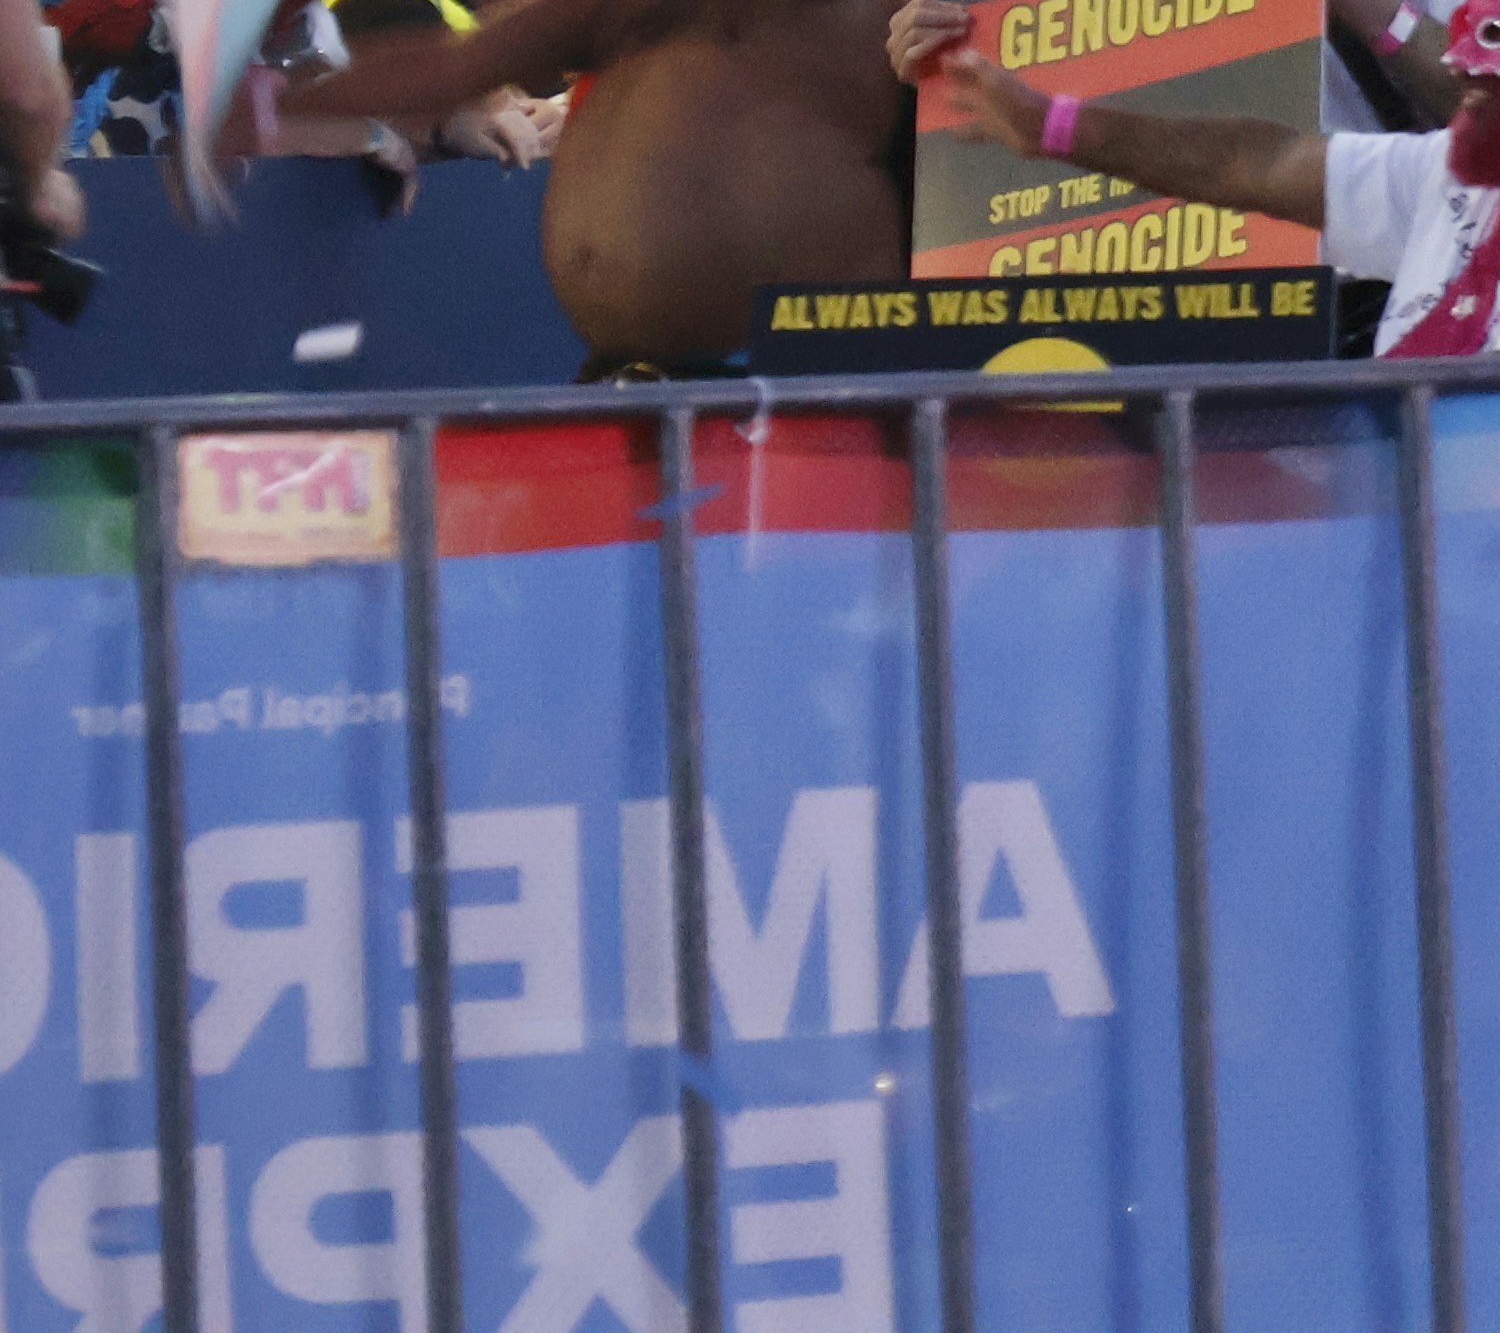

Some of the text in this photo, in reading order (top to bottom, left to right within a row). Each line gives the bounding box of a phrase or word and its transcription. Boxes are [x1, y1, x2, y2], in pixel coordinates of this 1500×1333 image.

[989, 184, 1049, 224] STOP
[1058, 172, 1104, 209] THE
[771, 279, 1317, 331] ALWAYS WAS ALWAYS WILL BE
